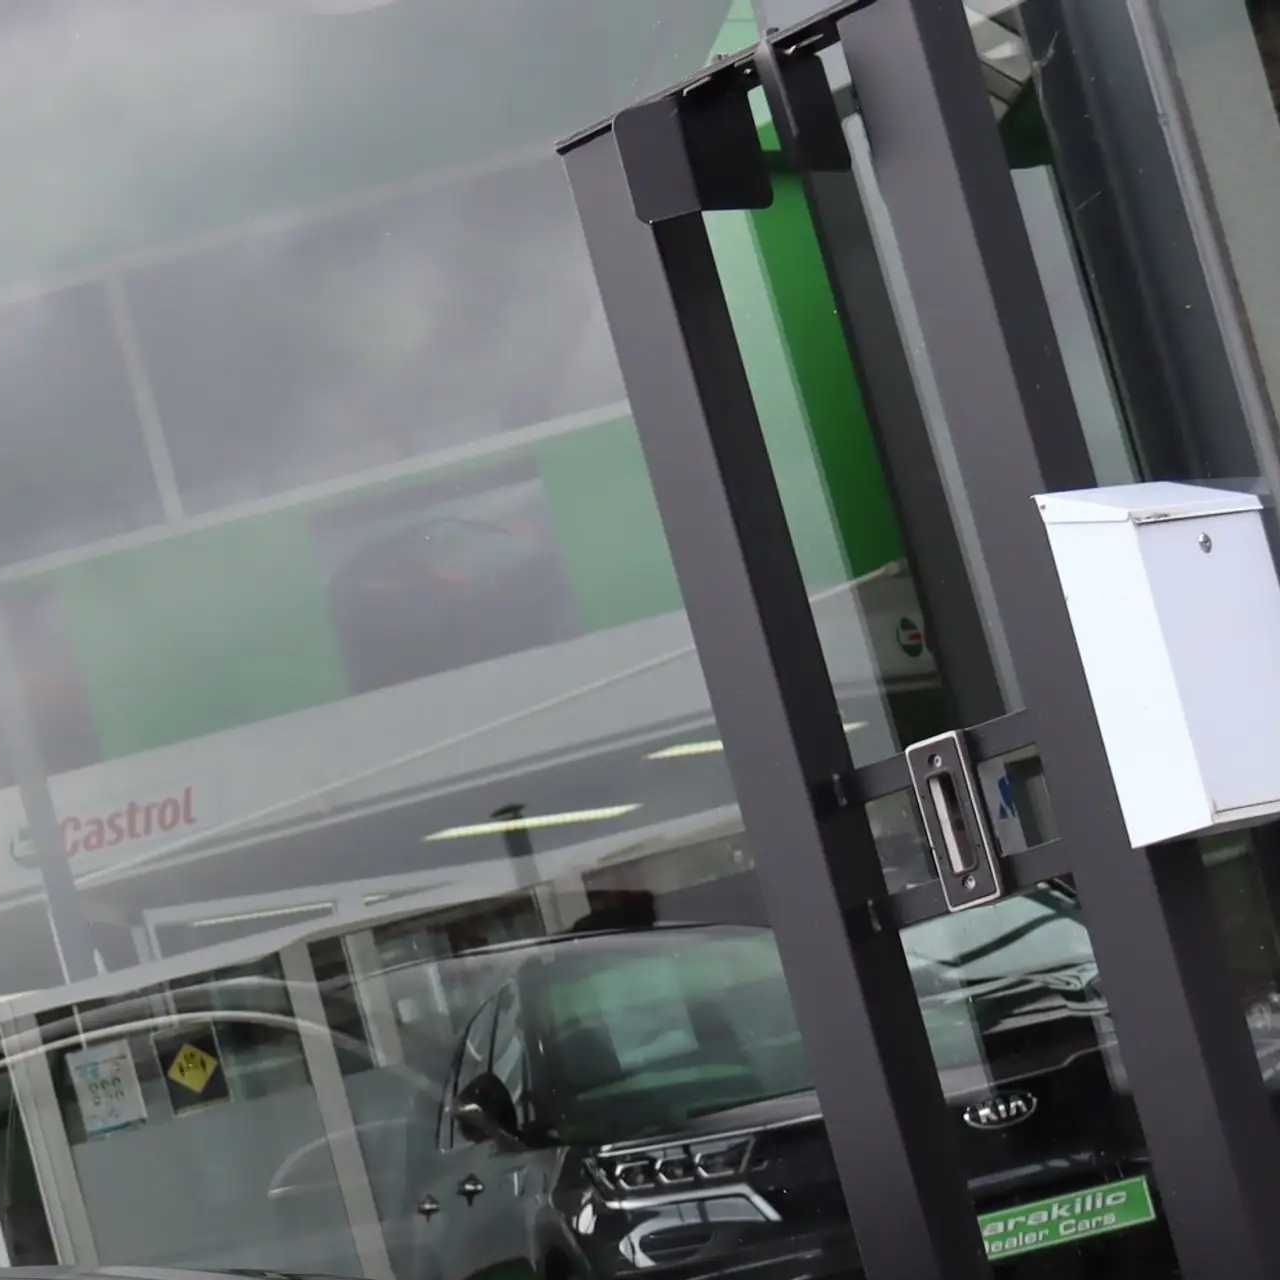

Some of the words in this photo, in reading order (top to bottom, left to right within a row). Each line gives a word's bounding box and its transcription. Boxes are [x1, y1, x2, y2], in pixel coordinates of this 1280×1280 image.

[59, 786, 197, 858] Castrol
[977, 1096, 1028, 1124] KIA
[1059, 1213, 1117, 1238] Cars
